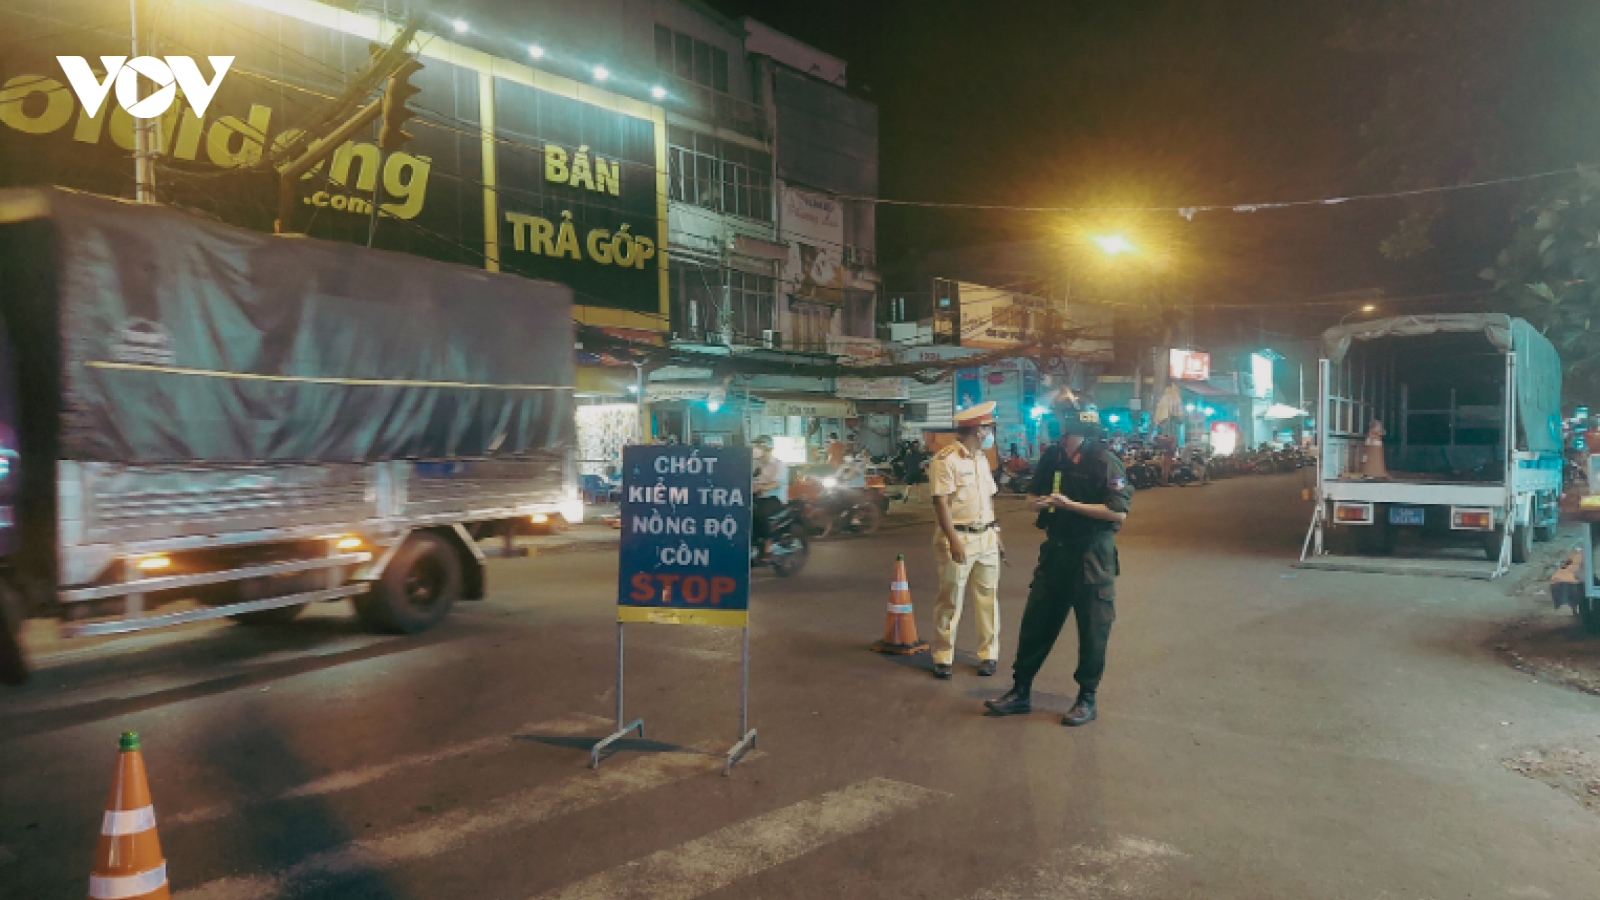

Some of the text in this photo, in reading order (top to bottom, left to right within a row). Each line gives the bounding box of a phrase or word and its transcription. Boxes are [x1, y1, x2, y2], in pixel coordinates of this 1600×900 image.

[545, 145, 620, 196] BÁN
[505, 210, 582, 260] TRẢ
[654, 450, 718, 475] CHỐT
[697, 487, 744, 507] TRA
[632, 508, 737, 540] NỒNG ĐỘ
[659, 540, 710, 566] CỒN
[630, 572, 737, 604] STOP
